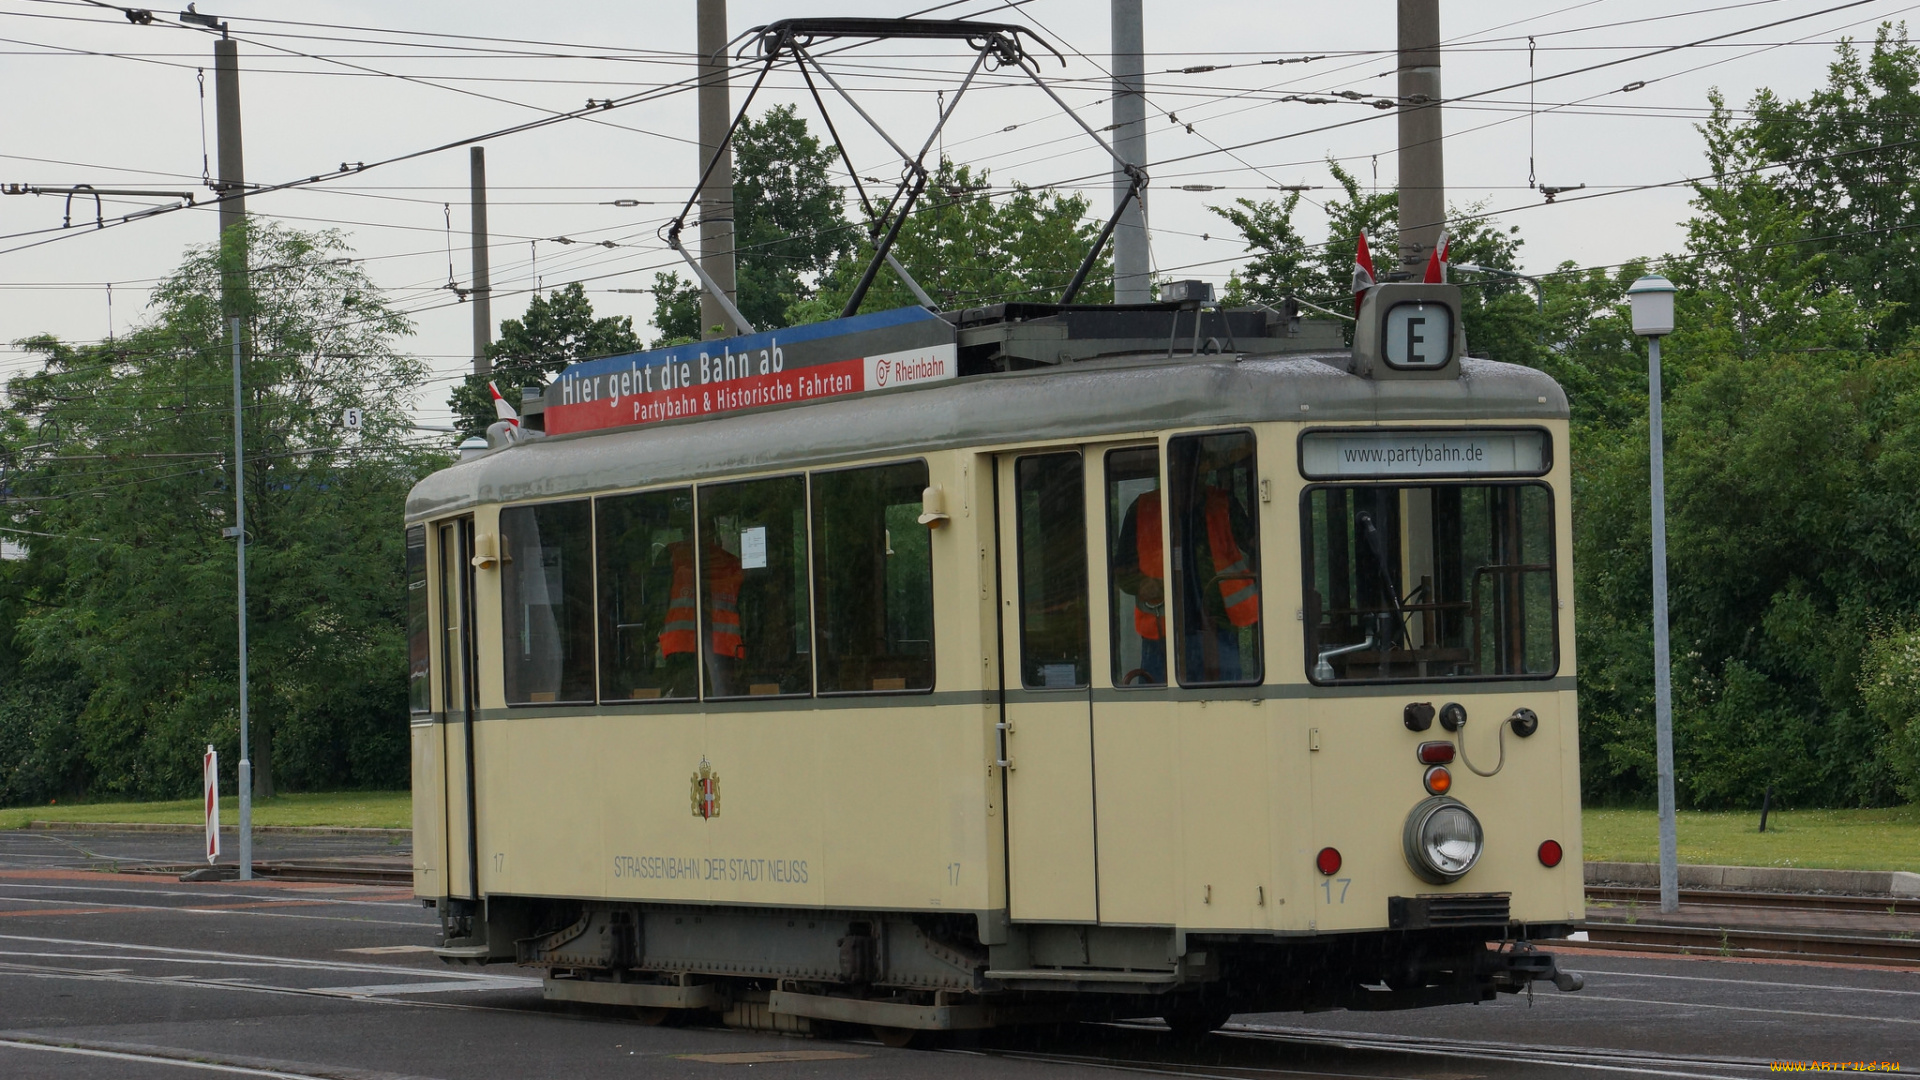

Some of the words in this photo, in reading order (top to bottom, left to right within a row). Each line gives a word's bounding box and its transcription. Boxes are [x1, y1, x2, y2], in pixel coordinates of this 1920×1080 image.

[1407, 317, 1425, 363] E
[562, 372, 601, 406] Hier
[609, 361, 652, 408] geht
[661, 354, 690, 391] die
[700, 346, 749, 384] Bahn
[759, 337, 784, 375] ab
[895, 355, 945, 382] Rheinbahn
[633, 394, 697, 421] Partybahn
[703, 392, 711, 411] &
[717, 379, 793, 409] Historische
[798, 372, 852, 398] Fahrten
[350, 411, 356, 425] 5
[1344, 443, 1483, 466] www.partybahn.de
[493, 852, 505, 874] 17
[614, 855, 700, 880] STRASSENBAHN
[704, 858, 727, 881] DER
[729, 858, 765, 882] STADT
[768, 859, 809, 884] NEUSS
[948, 863, 960, 886] 17
[1321, 879, 1351, 904] 17
